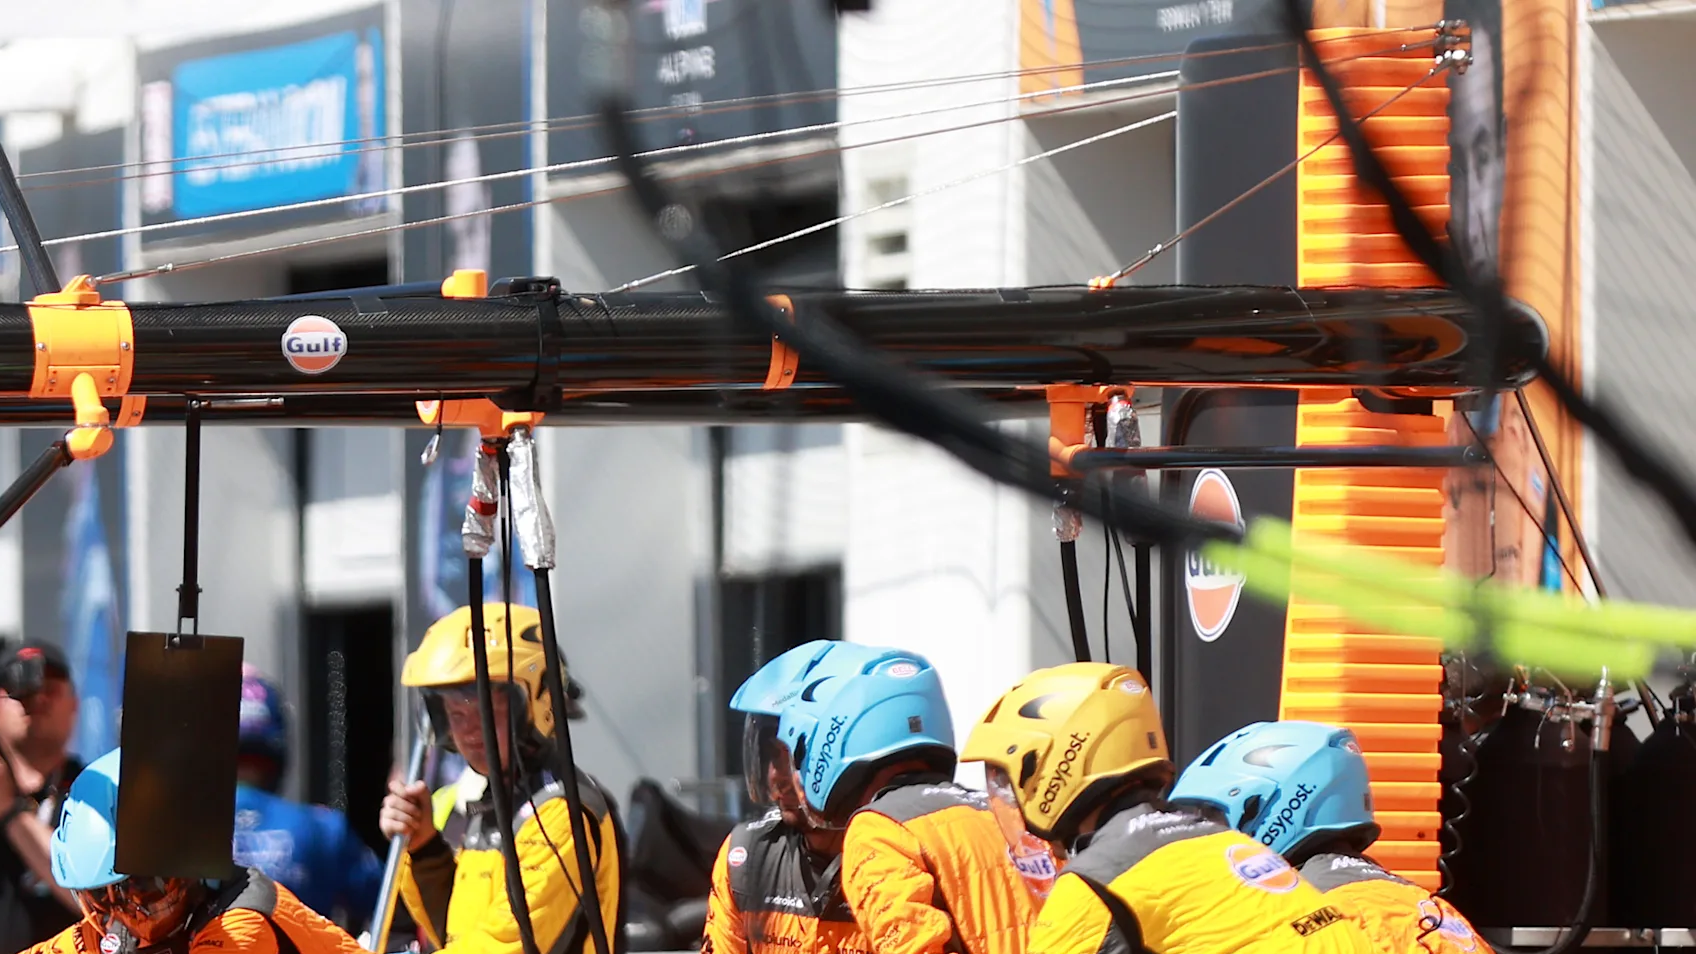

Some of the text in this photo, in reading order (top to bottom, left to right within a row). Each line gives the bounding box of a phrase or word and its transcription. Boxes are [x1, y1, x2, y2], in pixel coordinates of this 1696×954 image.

[286, 337, 342, 353] Gulf
[811, 715, 848, 794] easypost.
[1040, 731, 1091, 815] easypost.
[1261, 783, 1317, 846] asypost.
